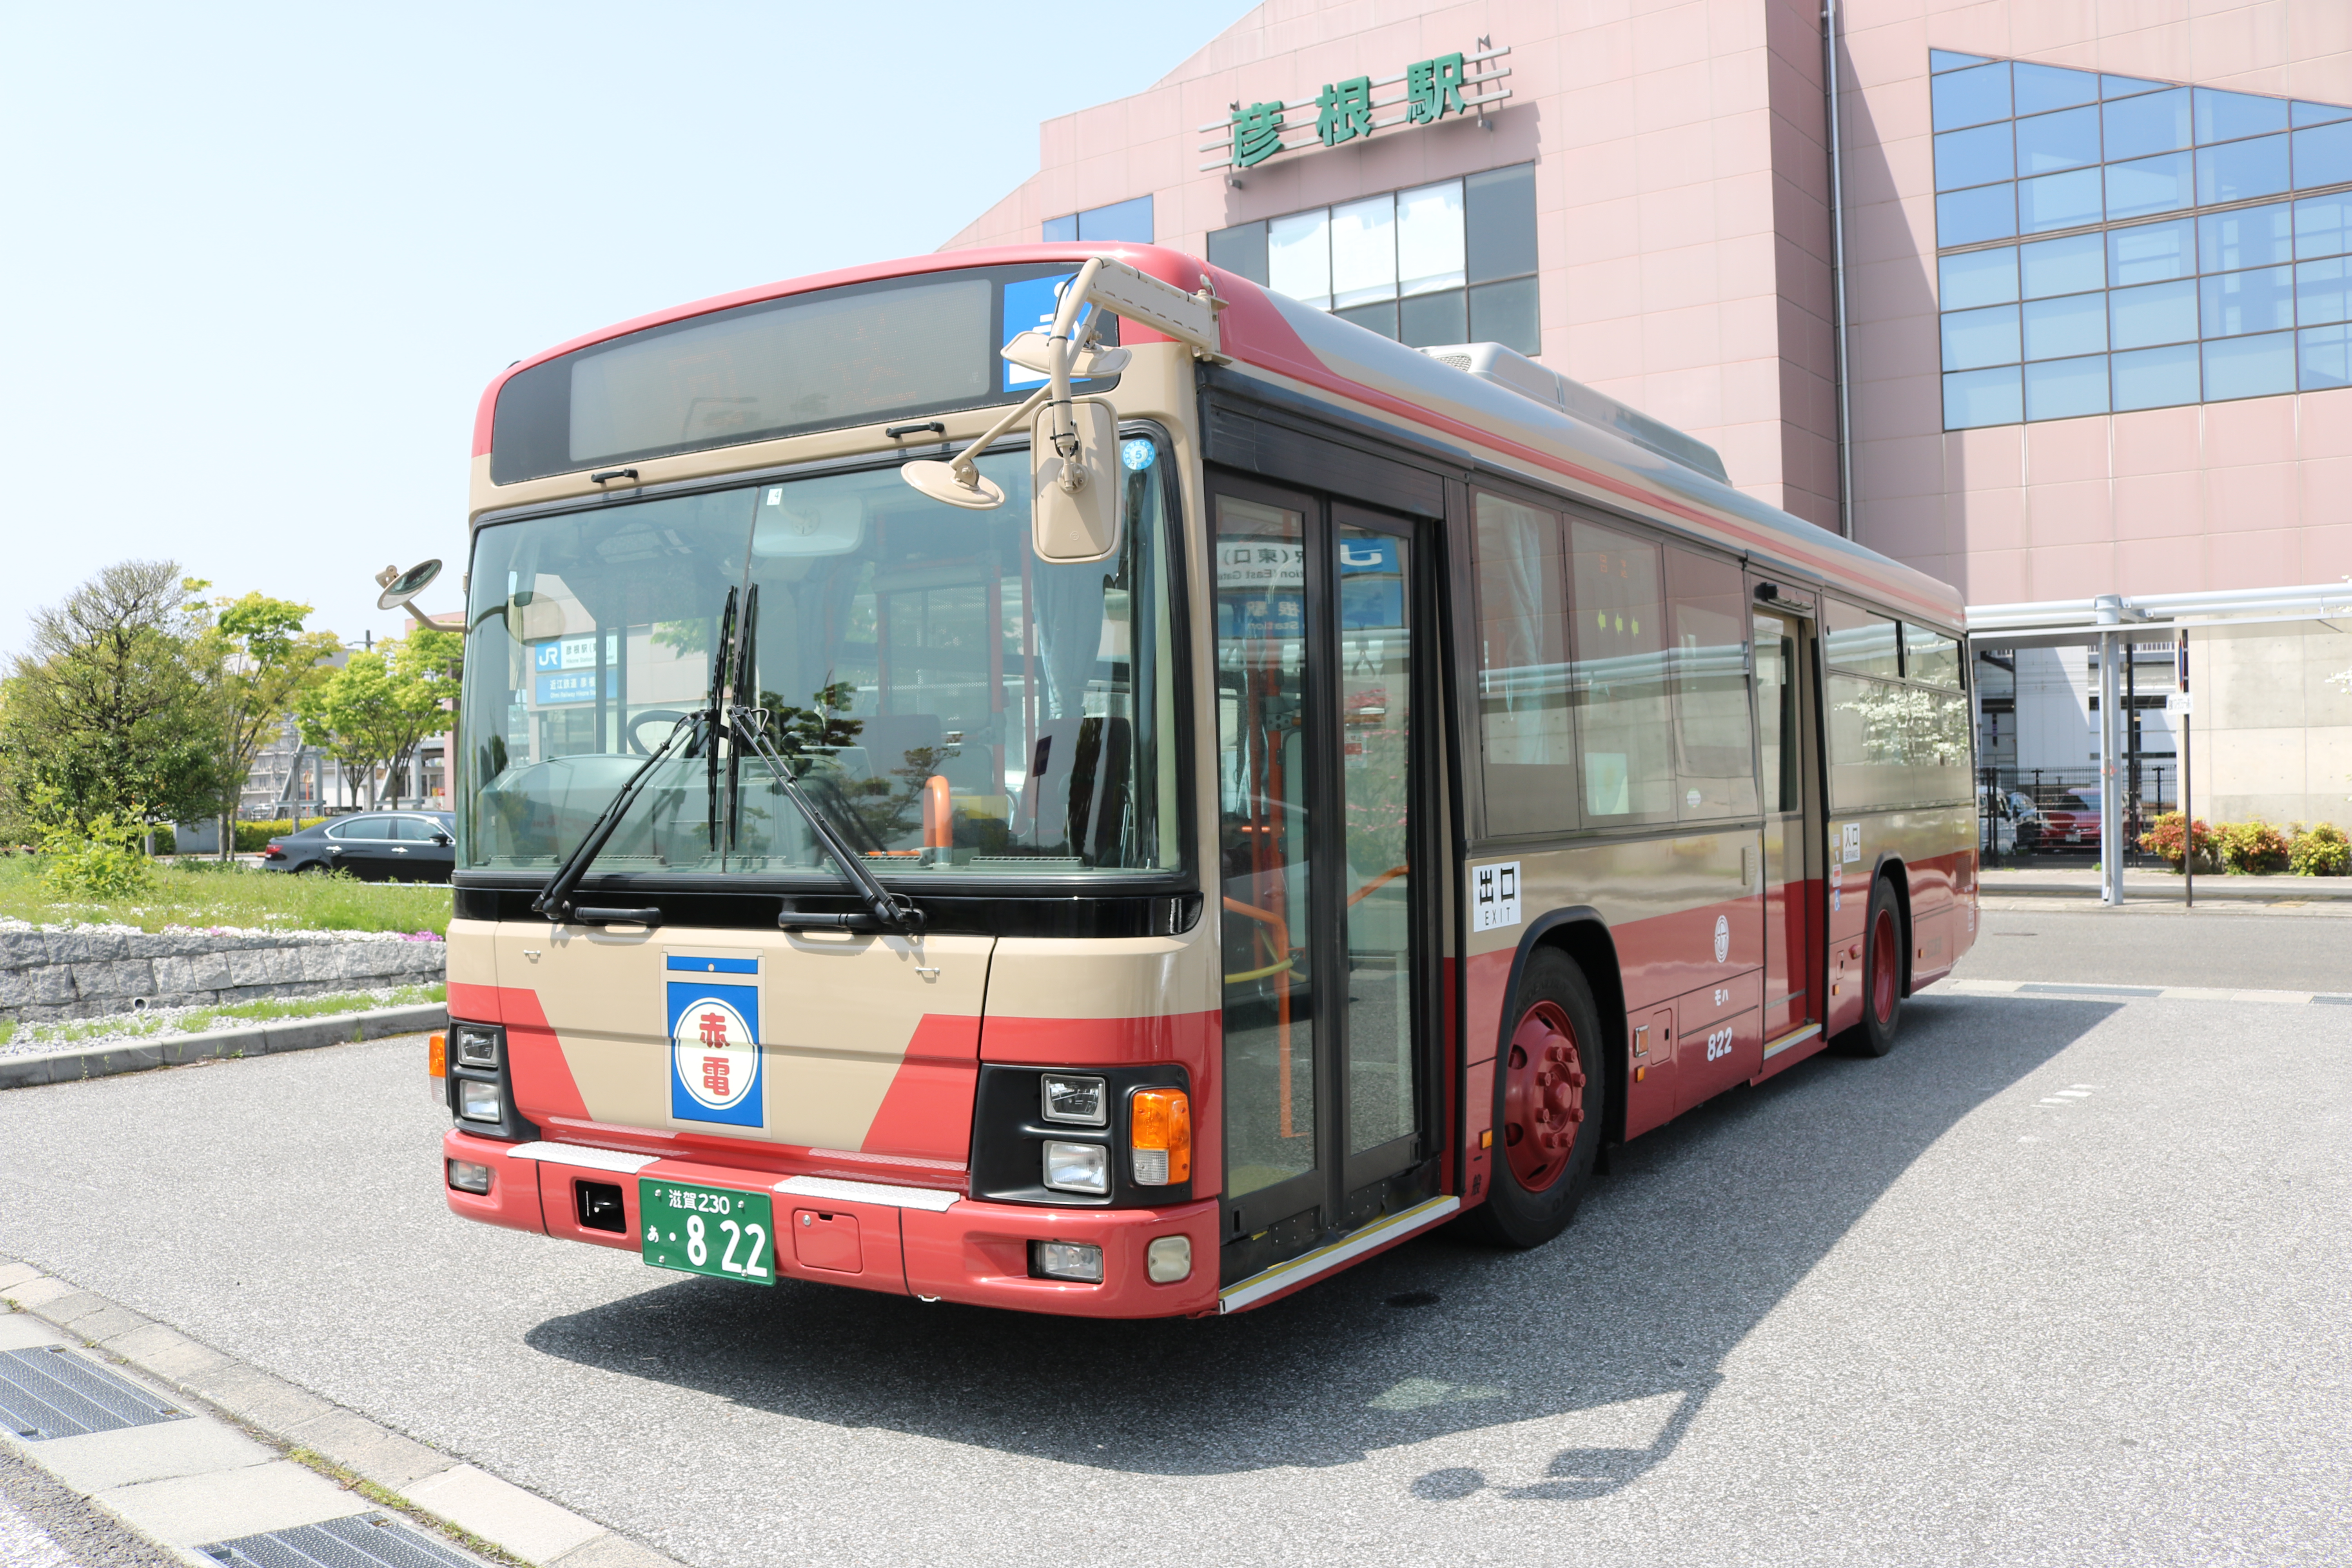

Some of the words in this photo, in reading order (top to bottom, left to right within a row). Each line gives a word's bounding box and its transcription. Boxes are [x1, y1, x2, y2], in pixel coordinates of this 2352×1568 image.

[1232, 52, 1467, 167] 彦根駅
[1135, 450, 1142, 459] 5
[774, 490, 779, 499] 4
[539, 647, 557, 666] JR
[550, 679, 577, 690] 近江鉄道
[1845, 826, 1858, 848] 入口
[1479, 866, 1515, 906] 出口
[1485, 907, 1510, 926] EXIT
[1715, 989, 1729, 1006] モハ
[1707, 1027, 1733, 1062] 822
[699, 1013, 731, 1096] 赤電
